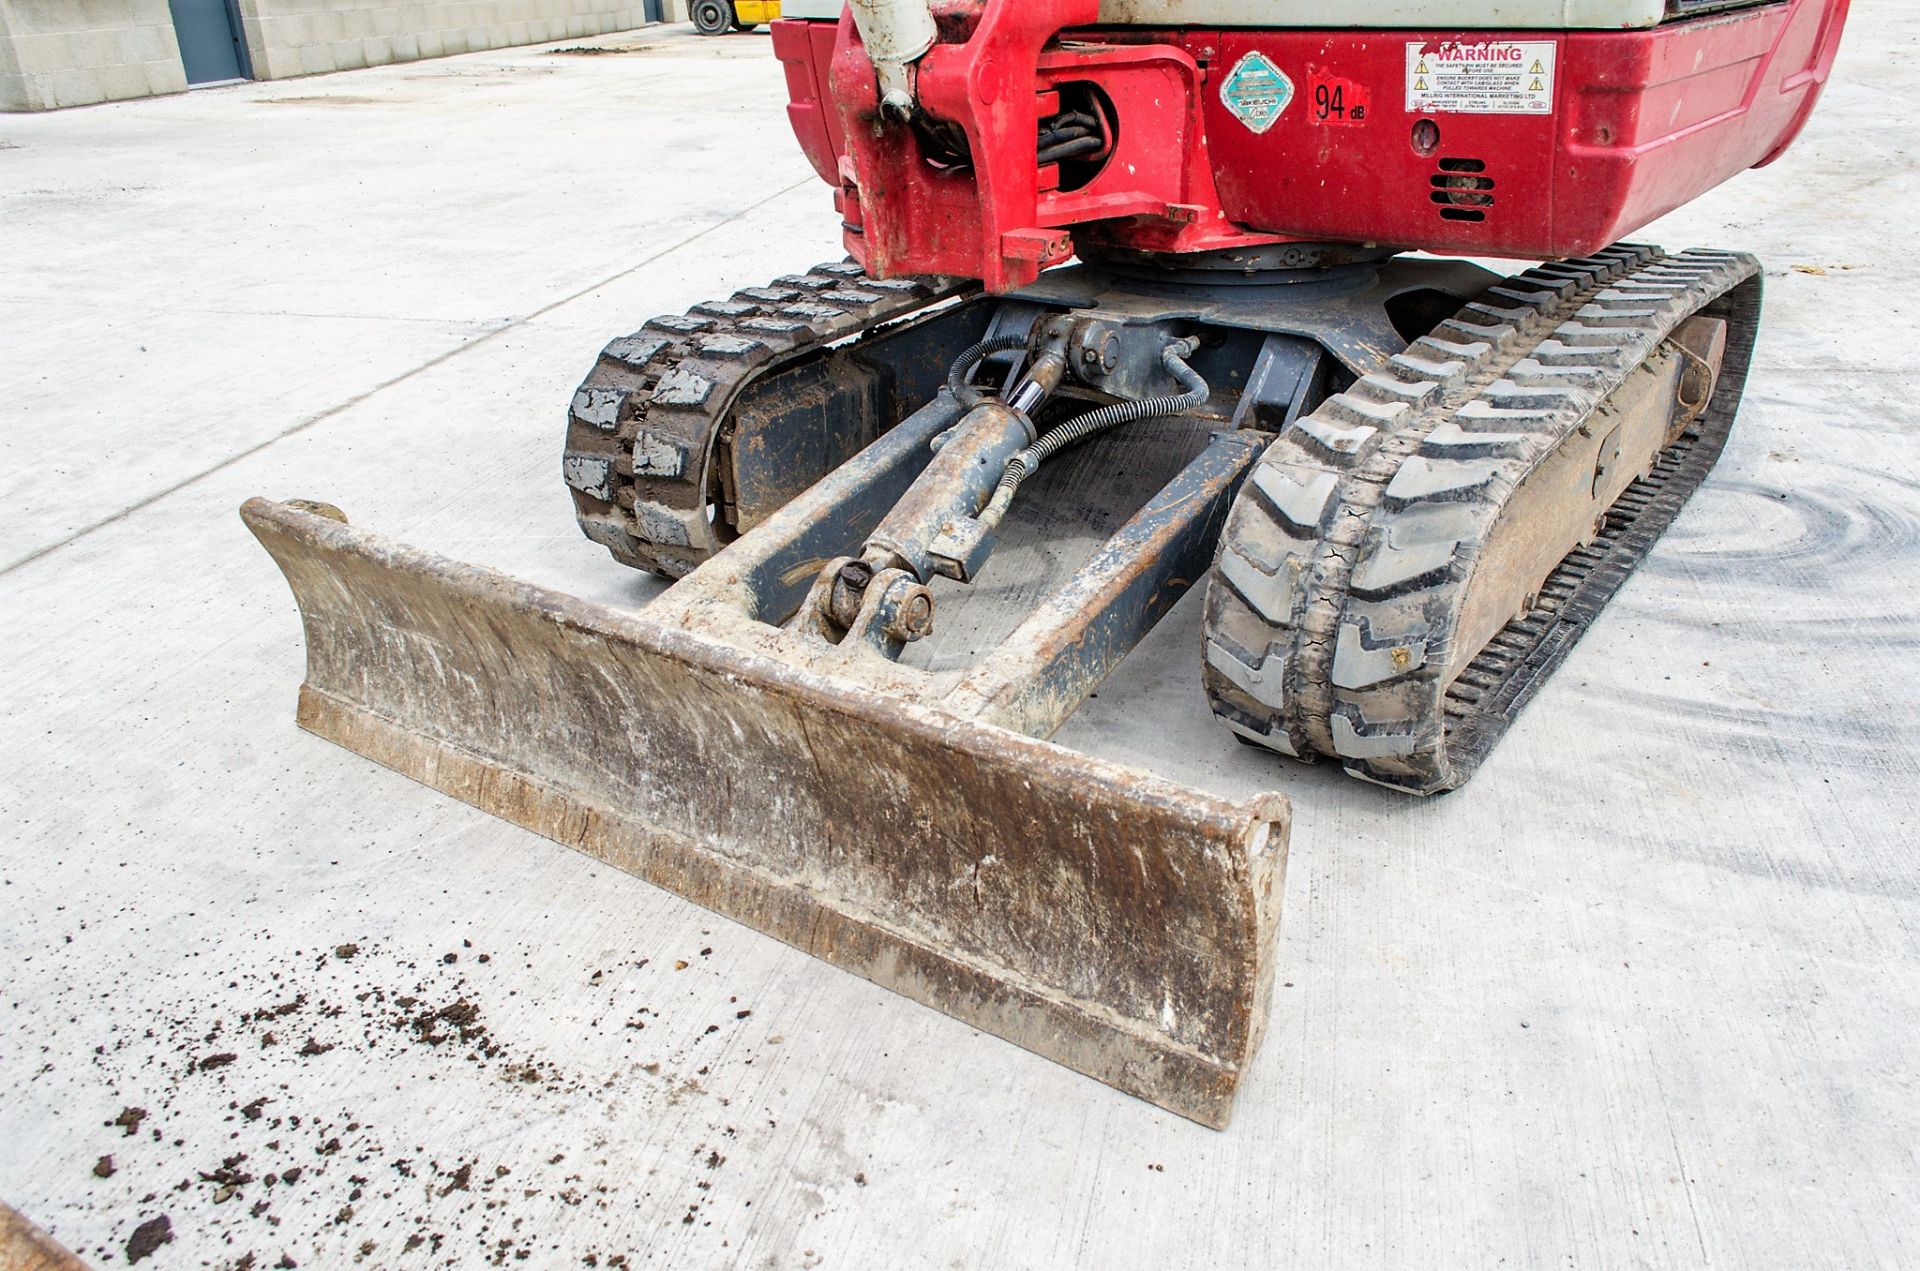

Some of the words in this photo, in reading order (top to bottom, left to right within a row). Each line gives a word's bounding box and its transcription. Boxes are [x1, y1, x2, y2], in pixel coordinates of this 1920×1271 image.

[1439, 48, 1522, 61] WARNING
[1316, 84, 1345, 119] 94
[1351, 106, 1365, 119] dB
